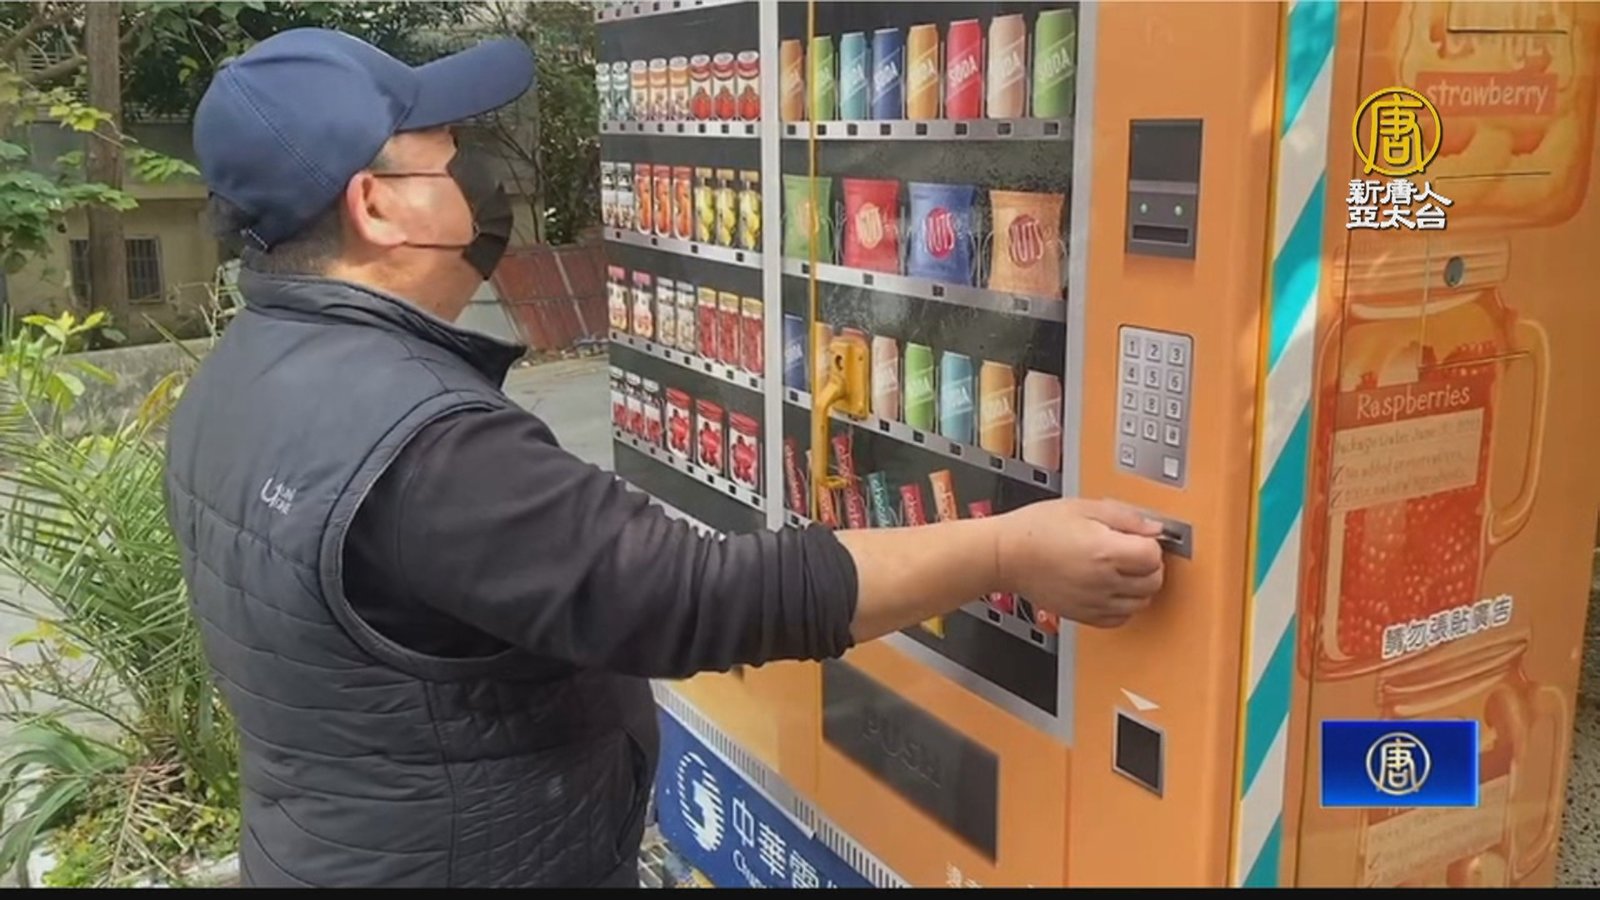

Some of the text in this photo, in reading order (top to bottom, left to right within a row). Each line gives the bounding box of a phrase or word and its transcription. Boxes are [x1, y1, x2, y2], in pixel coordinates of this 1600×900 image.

[948, 55, 978, 87] SODA
[1427, 76, 1548, 114] strawberry
[1150, 343, 1158, 357] 2
[1173, 348, 1181, 361] 3
[1149, 370, 1157, 383] 5
[1171, 375, 1179, 388] 6
[1170, 402, 1178, 415] 9
[1356, 383, 1471, 421] Raspberries
[1382, 595, 1512, 659] 請勿張貼廣告
[733, 797, 838, 888] 中華電
